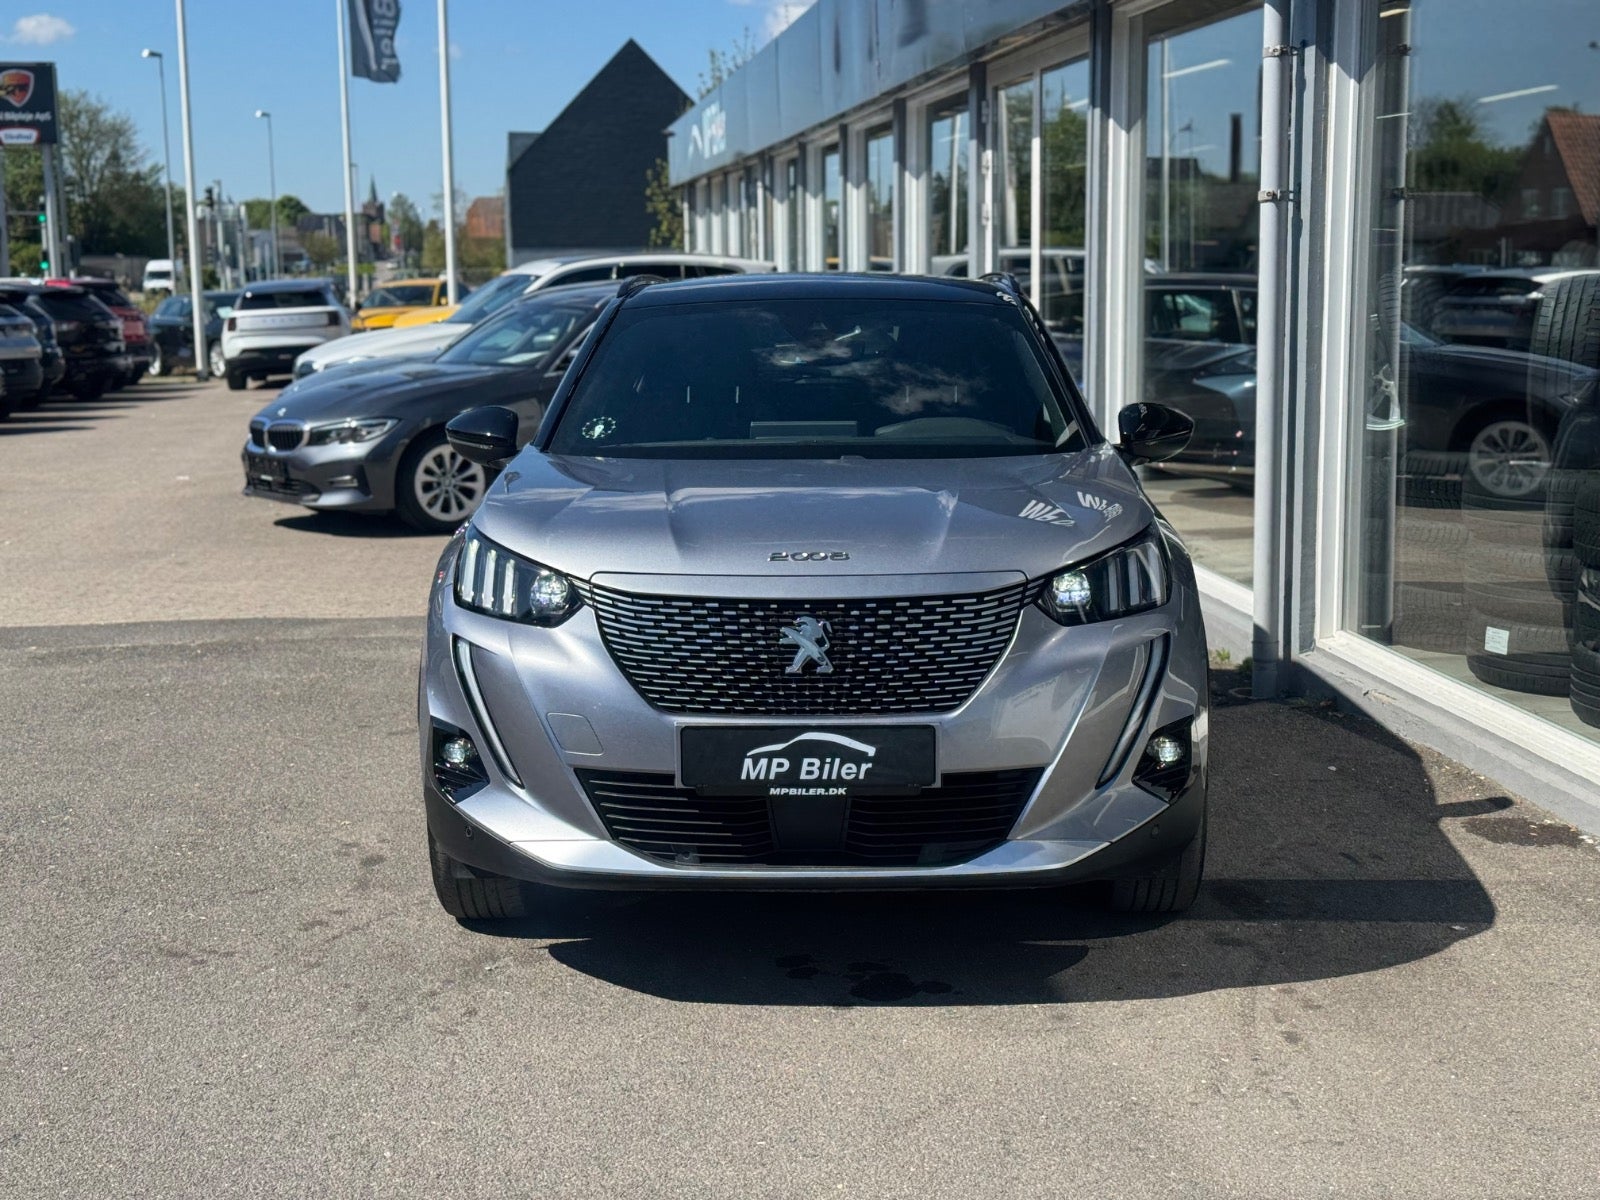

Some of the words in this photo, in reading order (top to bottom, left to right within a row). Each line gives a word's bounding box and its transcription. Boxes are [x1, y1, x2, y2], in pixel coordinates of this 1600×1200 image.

[767, 552, 851, 562] 2008
[741, 758, 790, 780] MP
[800, 758, 872, 780] Biler
[769, 787, 847, 796] MPBILER.DK
